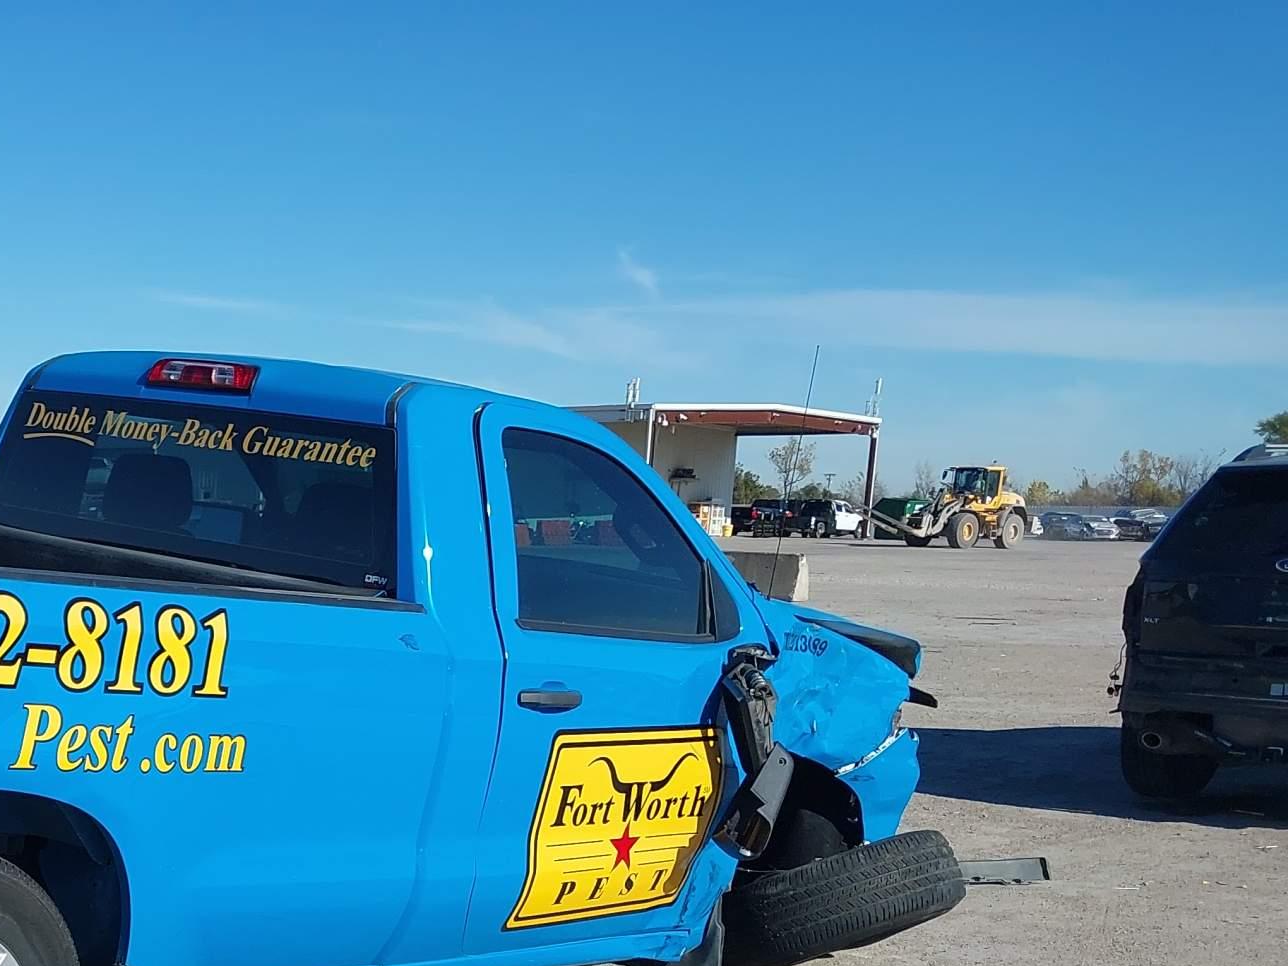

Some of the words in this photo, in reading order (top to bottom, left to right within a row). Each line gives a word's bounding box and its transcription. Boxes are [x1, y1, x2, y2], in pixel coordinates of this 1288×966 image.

[24, 402, 96, 435] Double
[98, 410, 238, 452] Money-Back
[242, 426, 377, 468] Guarantee
[550, 785, 616, 828] Fort
[620, 782, 706, 825] Worth
[553, 869, 669, 905] PEST
